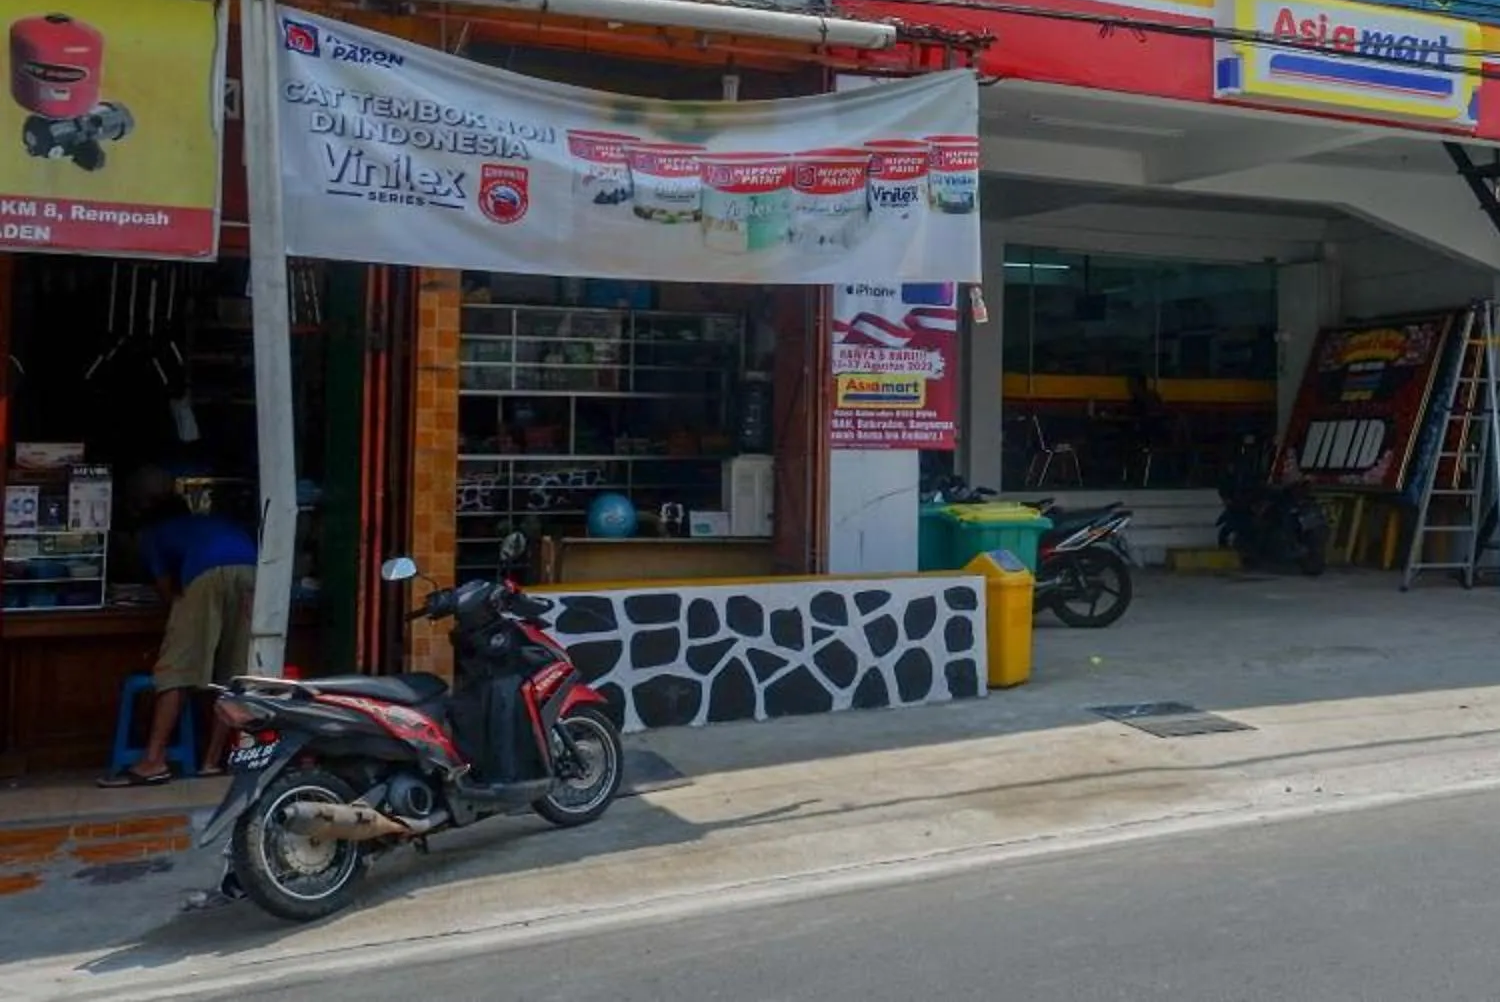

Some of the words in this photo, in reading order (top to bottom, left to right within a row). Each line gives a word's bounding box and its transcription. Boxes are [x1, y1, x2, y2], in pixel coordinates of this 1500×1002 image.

[285, 82, 345, 107] CAT
[351, 94, 487, 130] TEMBOK
[311, 112, 346, 136] DI
[353, 116, 533, 161] INDONESIA
[325, 142, 467, 200] Vinilex
[734, 165, 788, 176] NIPPON
[817, 167, 863, 178] NIPPON
[741, 174, 782, 187] PAINT
[821, 176, 856, 187] PAINT
[368, 191, 427, 207] SERIES
[2, 201, 36, 216] KM
[43, 203, 63, 222] 8,
[71, 205, 169, 226] Rempoah
[855, 284, 896, 297] iPhone
